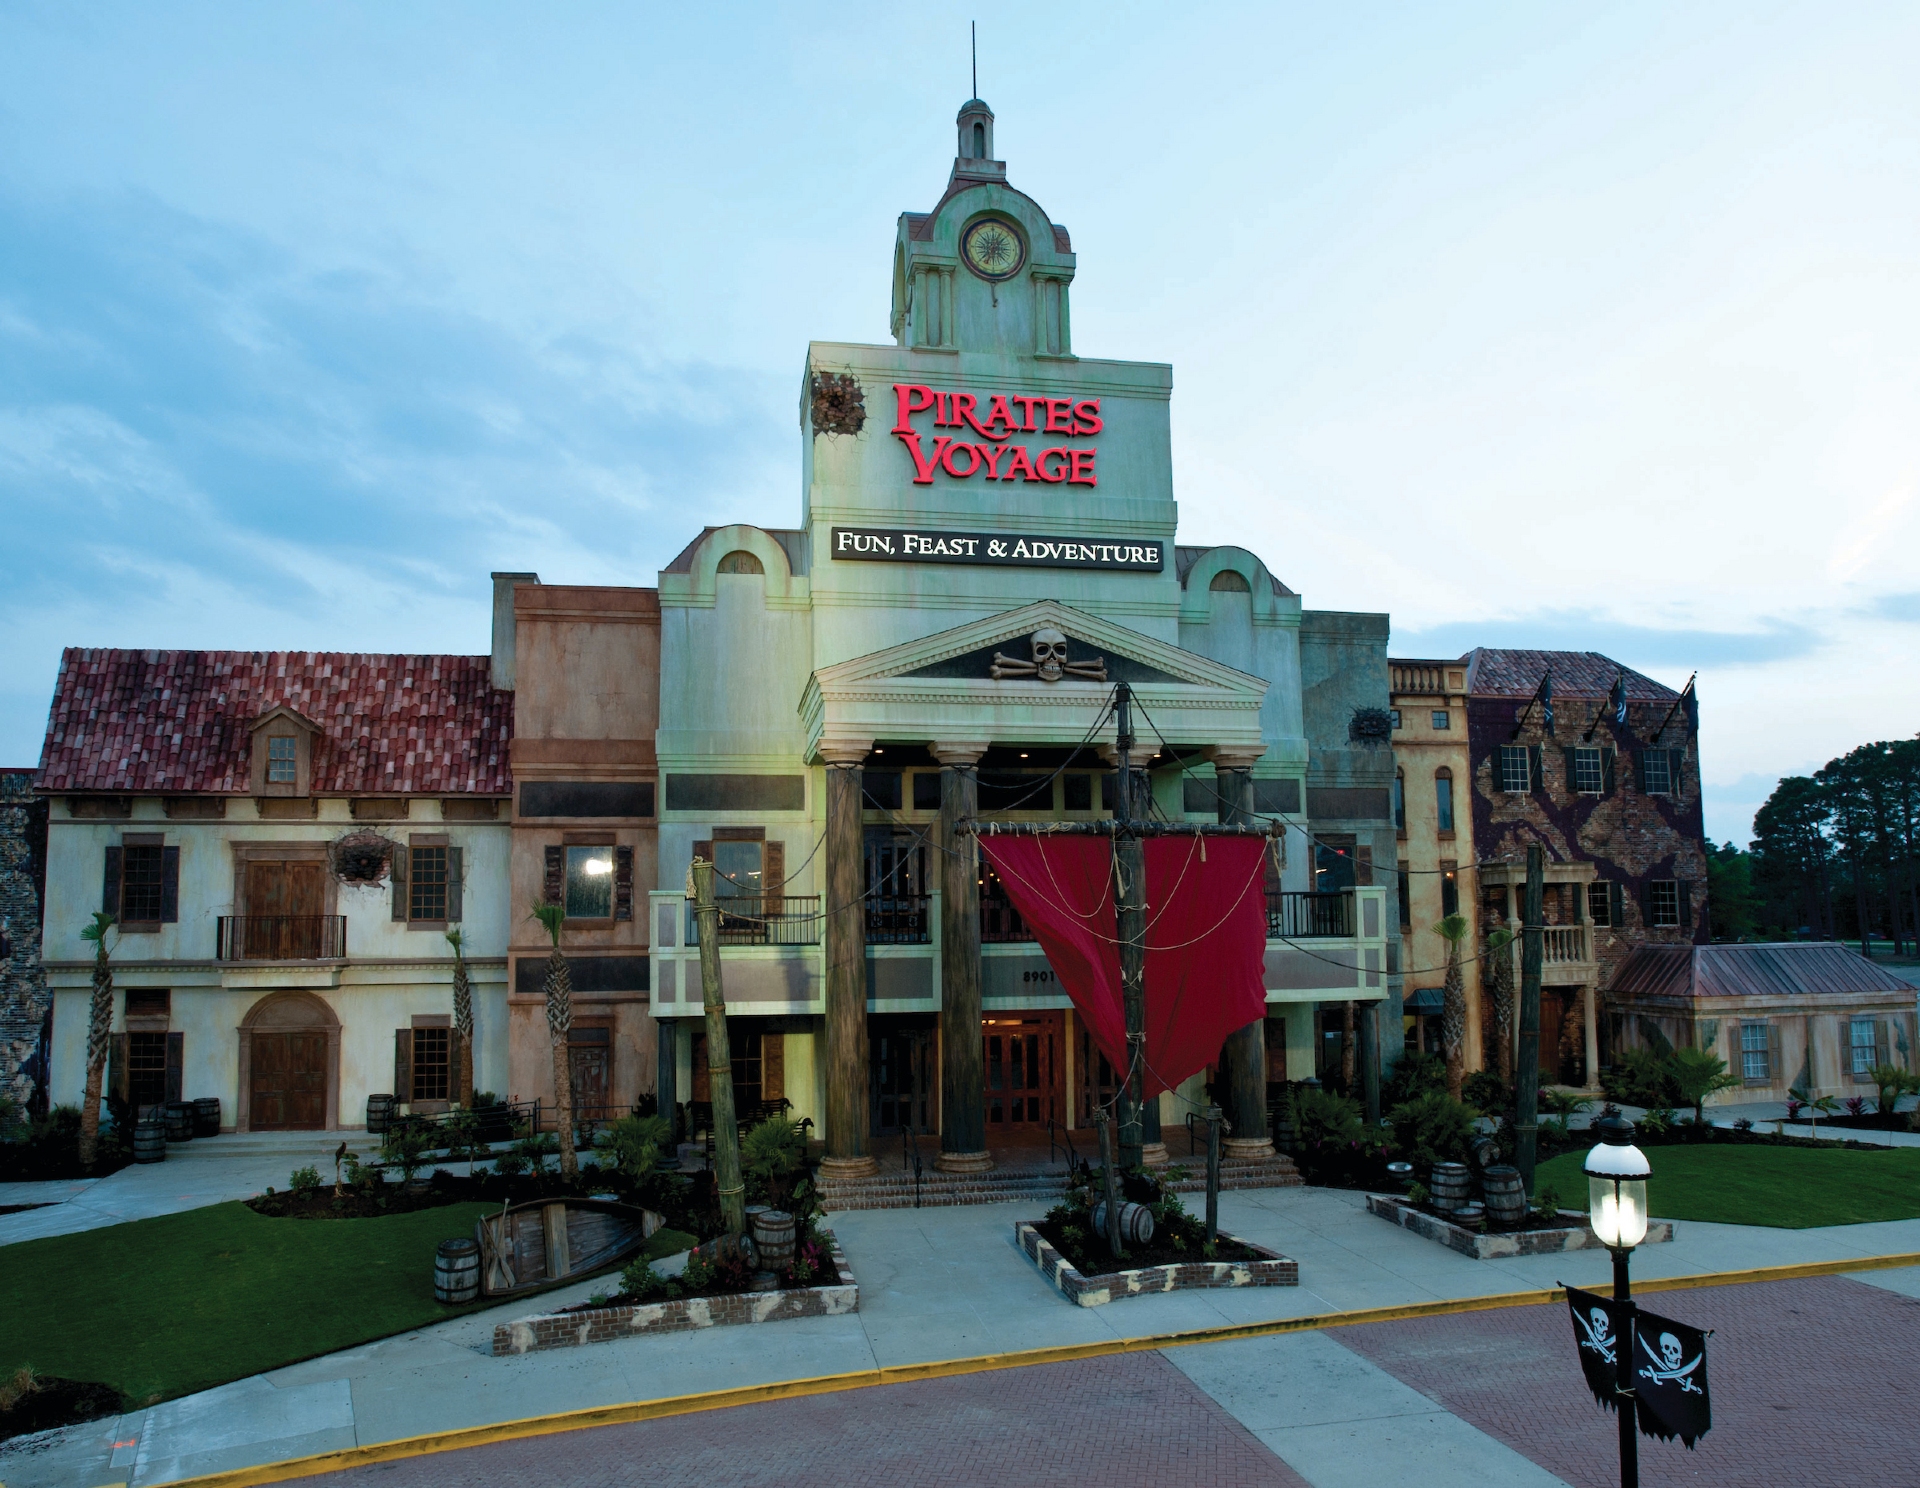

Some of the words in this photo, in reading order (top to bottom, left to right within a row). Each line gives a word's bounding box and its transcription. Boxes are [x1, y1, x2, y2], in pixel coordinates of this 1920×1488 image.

[891, 384, 1103, 440] PIRATES
[899, 434, 1098, 487] VOYAGE
[837, 531, 896, 555] FUN,
[902, 534, 980, 556] FEAST
[987, 539, 1008, 558] &
[1011, 538, 1159, 564] ADVENTURE
[1023, 970, 1055, 982] 8901
